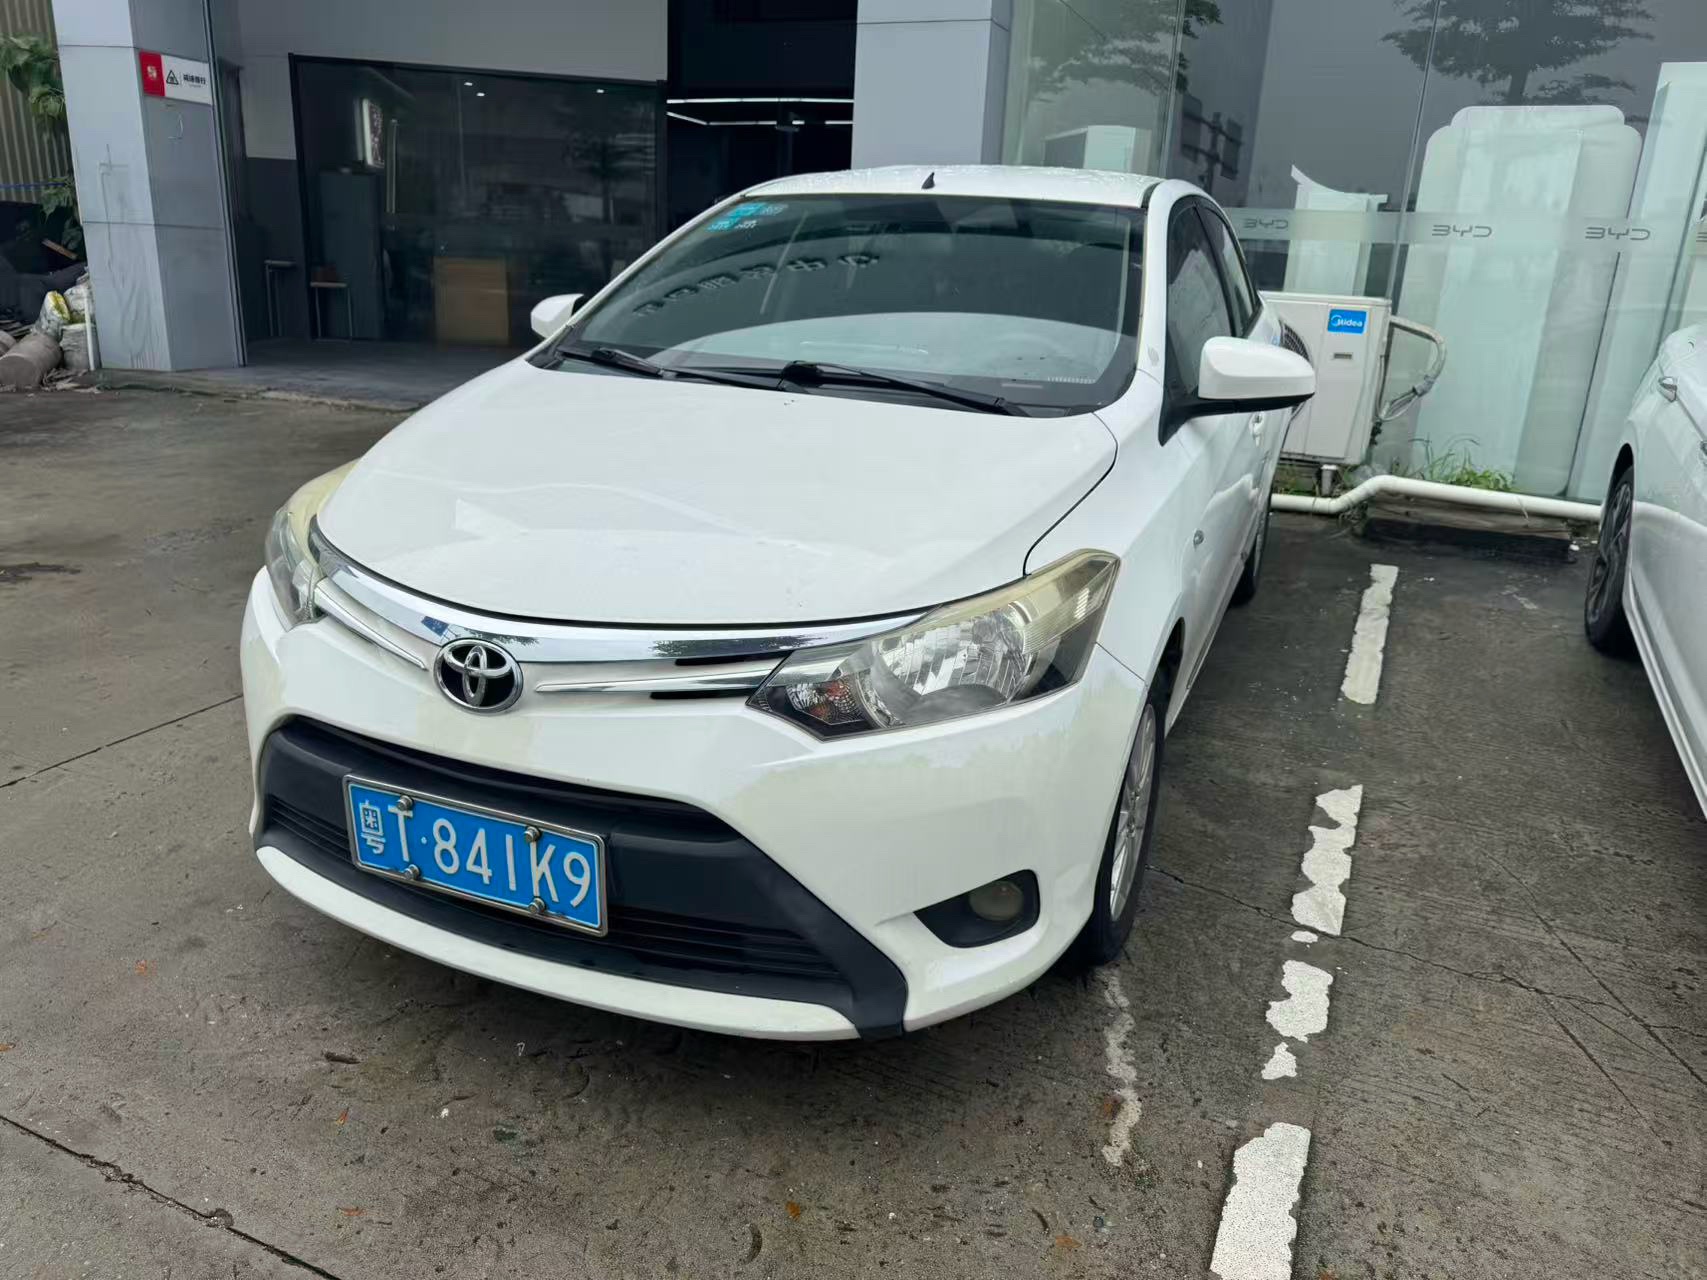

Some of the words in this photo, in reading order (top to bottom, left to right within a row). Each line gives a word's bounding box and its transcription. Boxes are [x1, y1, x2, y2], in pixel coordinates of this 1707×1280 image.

[1243, 218, 1288, 230] BYD
[1432, 224, 1493, 238] BYD
[1585, 225, 1651, 241] BYD
[1333, 316, 1363, 328] Midea
